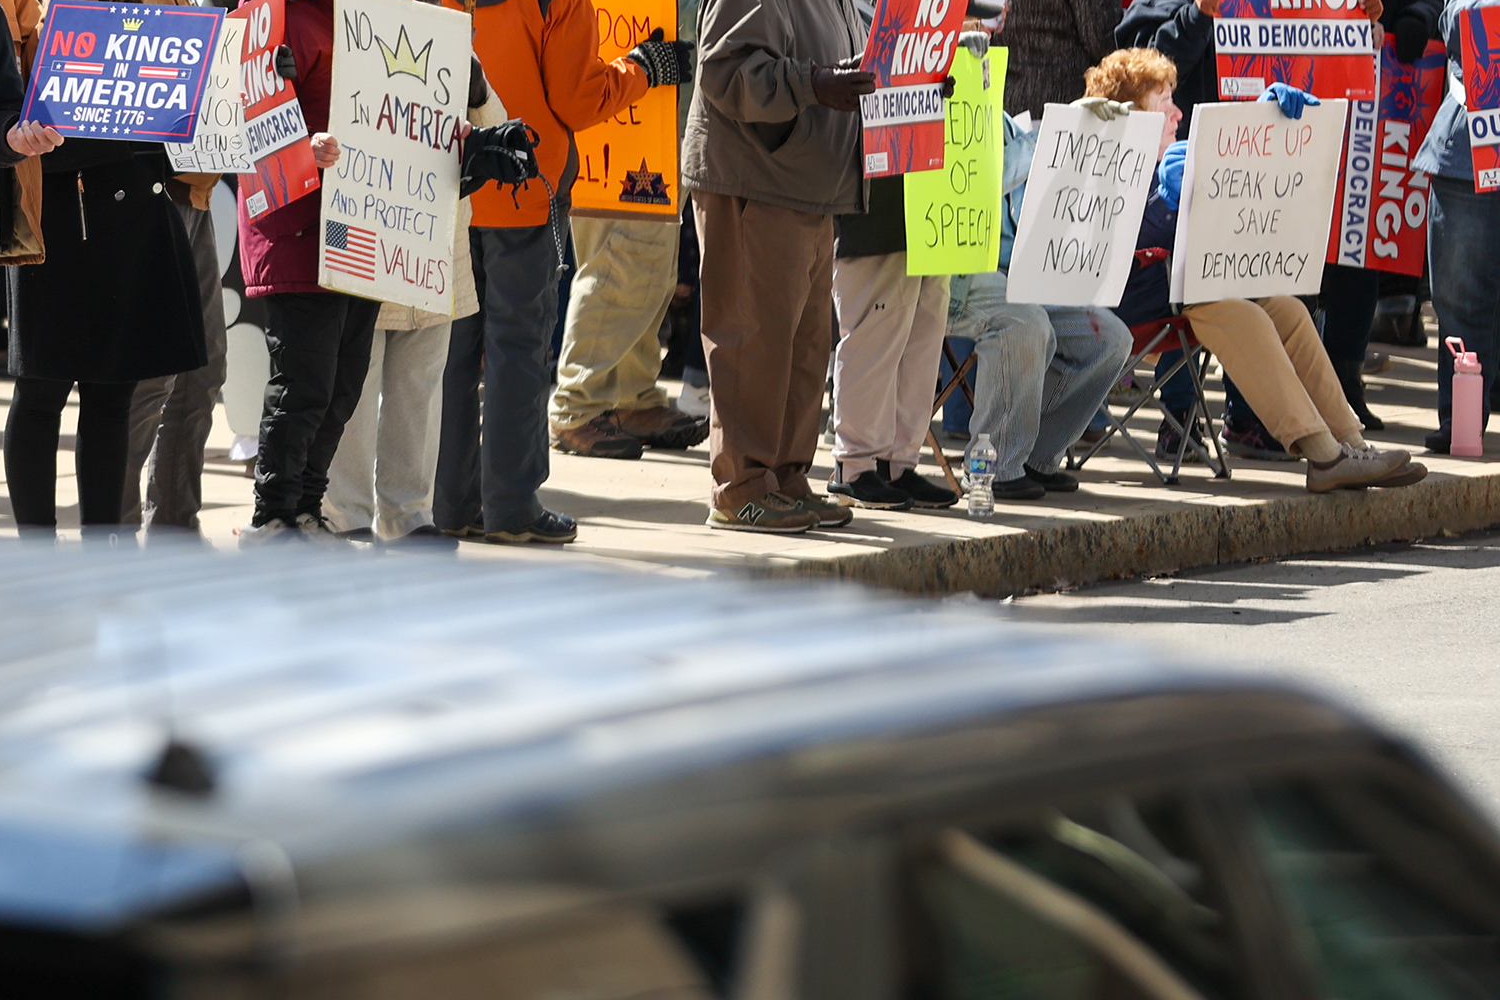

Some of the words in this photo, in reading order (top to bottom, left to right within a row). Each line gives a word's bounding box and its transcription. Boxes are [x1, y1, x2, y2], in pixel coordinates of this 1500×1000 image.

[50, 30, 97, 59] NO
[103, 32, 204, 66] KINGS
[248, 2, 272, 55] NO
[343, 9, 373, 53] NO
[1216, 23, 1251, 48] OUR
[1258, 23, 1369, 48] DEMOCRACY
[112, 61, 130, 79] IN
[890, 30, 954, 77] KINGS
[38, 75, 188, 111] AMERICA
[862, 94, 881, 120] OUR
[882, 82, 945, 118] DEMOCRACY
[72, 105, 112, 124] SINCE
[114, 109, 146, 127] 1776
[376, 93, 463, 166] AMERICA
[195, 149, 251, 173] FILES
[1047, 129, 1146, 188] IMPEACH
[1217, 123, 1275, 158] WAKE
[1285, 124, 1313, 158] UP
[337, 143, 394, 192] JOIN
[407, 165, 437, 203] US
[950, 158, 978, 195] OF
[1207, 167, 1268, 201] SPEAK
[1273, 171, 1304, 199] UP
[1343, 100, 1376, 266] DEMOCRACY
[1372, 119, 1411, 260] KINGS
[330, 187, 358, 218] AND
[364, 192, 438, 242] PROTECT
[923, 201, 992, 250] SPEECH
[1052, 185, 1125, 232] TRUMP
[1233, 207, 1282, 236] SAVE
[380, 238, 449, 296] VALUES
[1042, 237, 1109, 278] NOW!
[1200, 251, 1310, 284] DEMOCRACY
